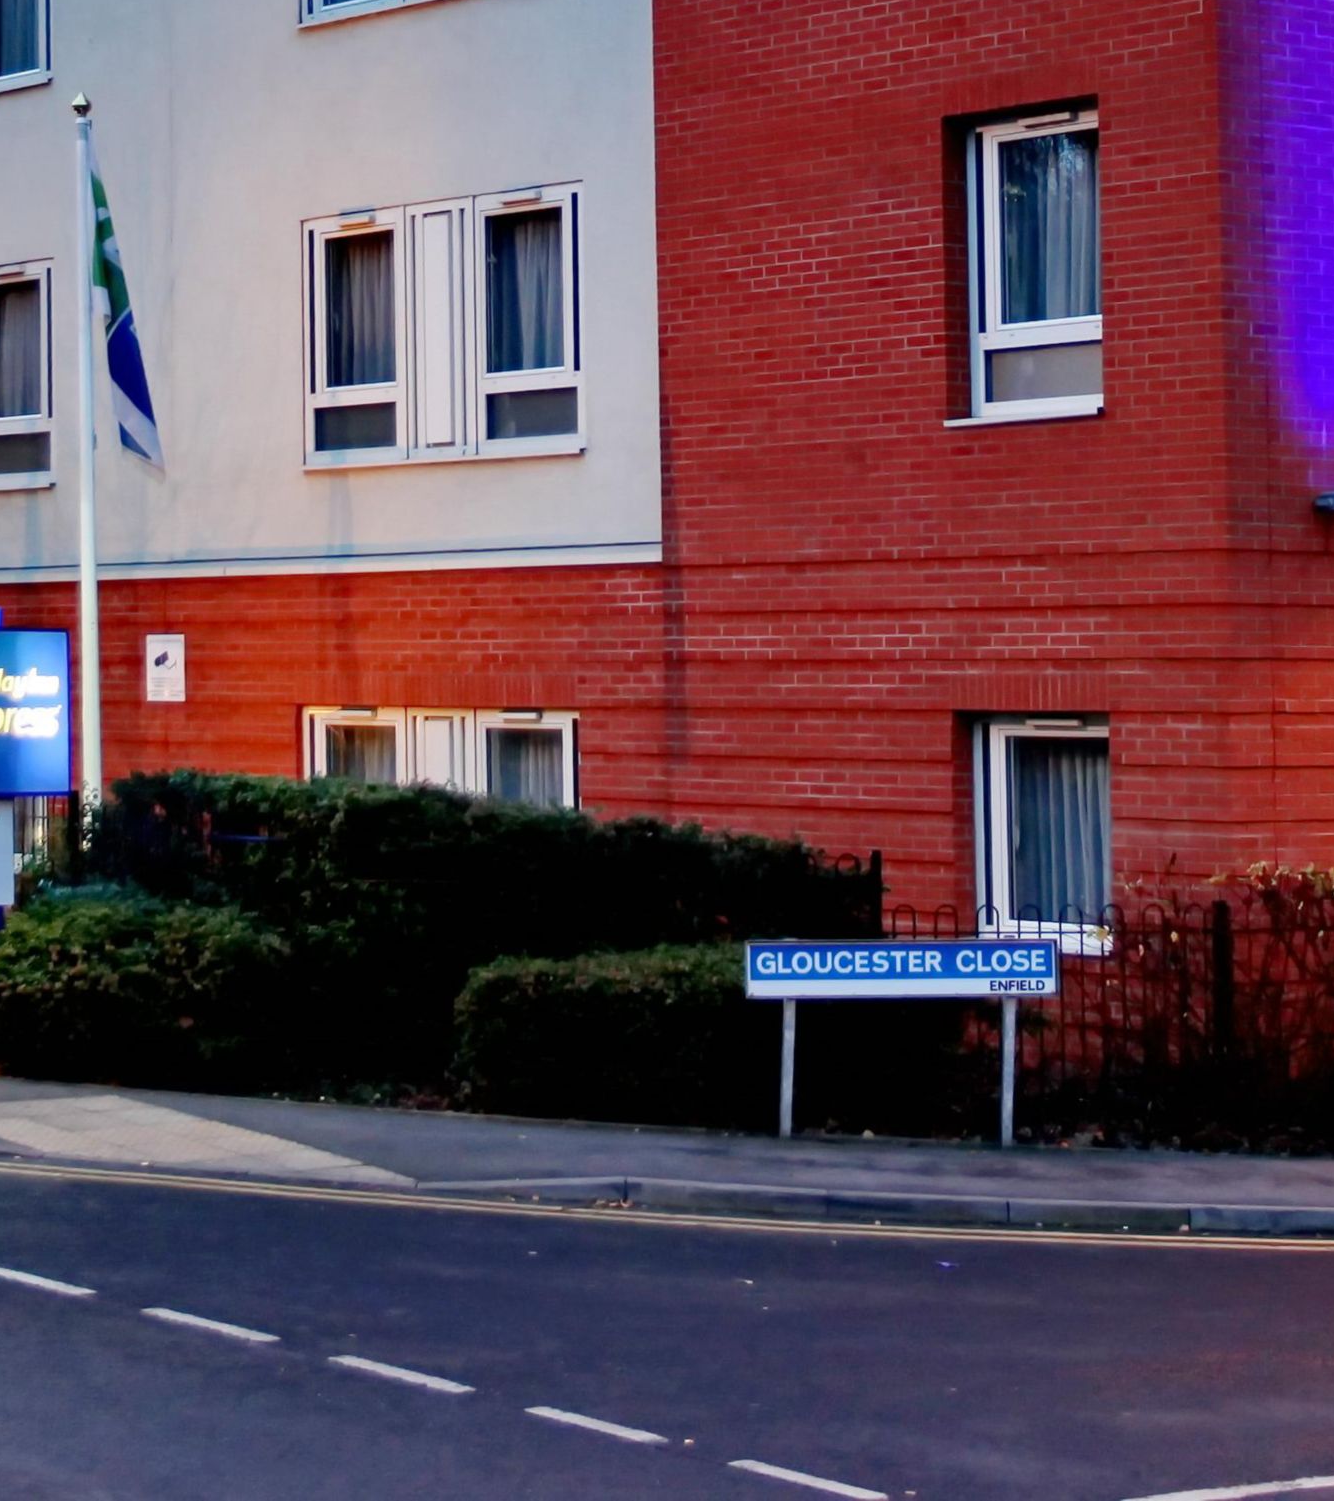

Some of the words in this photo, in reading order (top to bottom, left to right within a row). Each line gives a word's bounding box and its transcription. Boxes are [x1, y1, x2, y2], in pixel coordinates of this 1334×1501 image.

[755, 950, 943, 975] GLOUCESTER
[955, 949, 1047, 973] CLOSE
[989, 979, 1046, 992] ENFIELD
